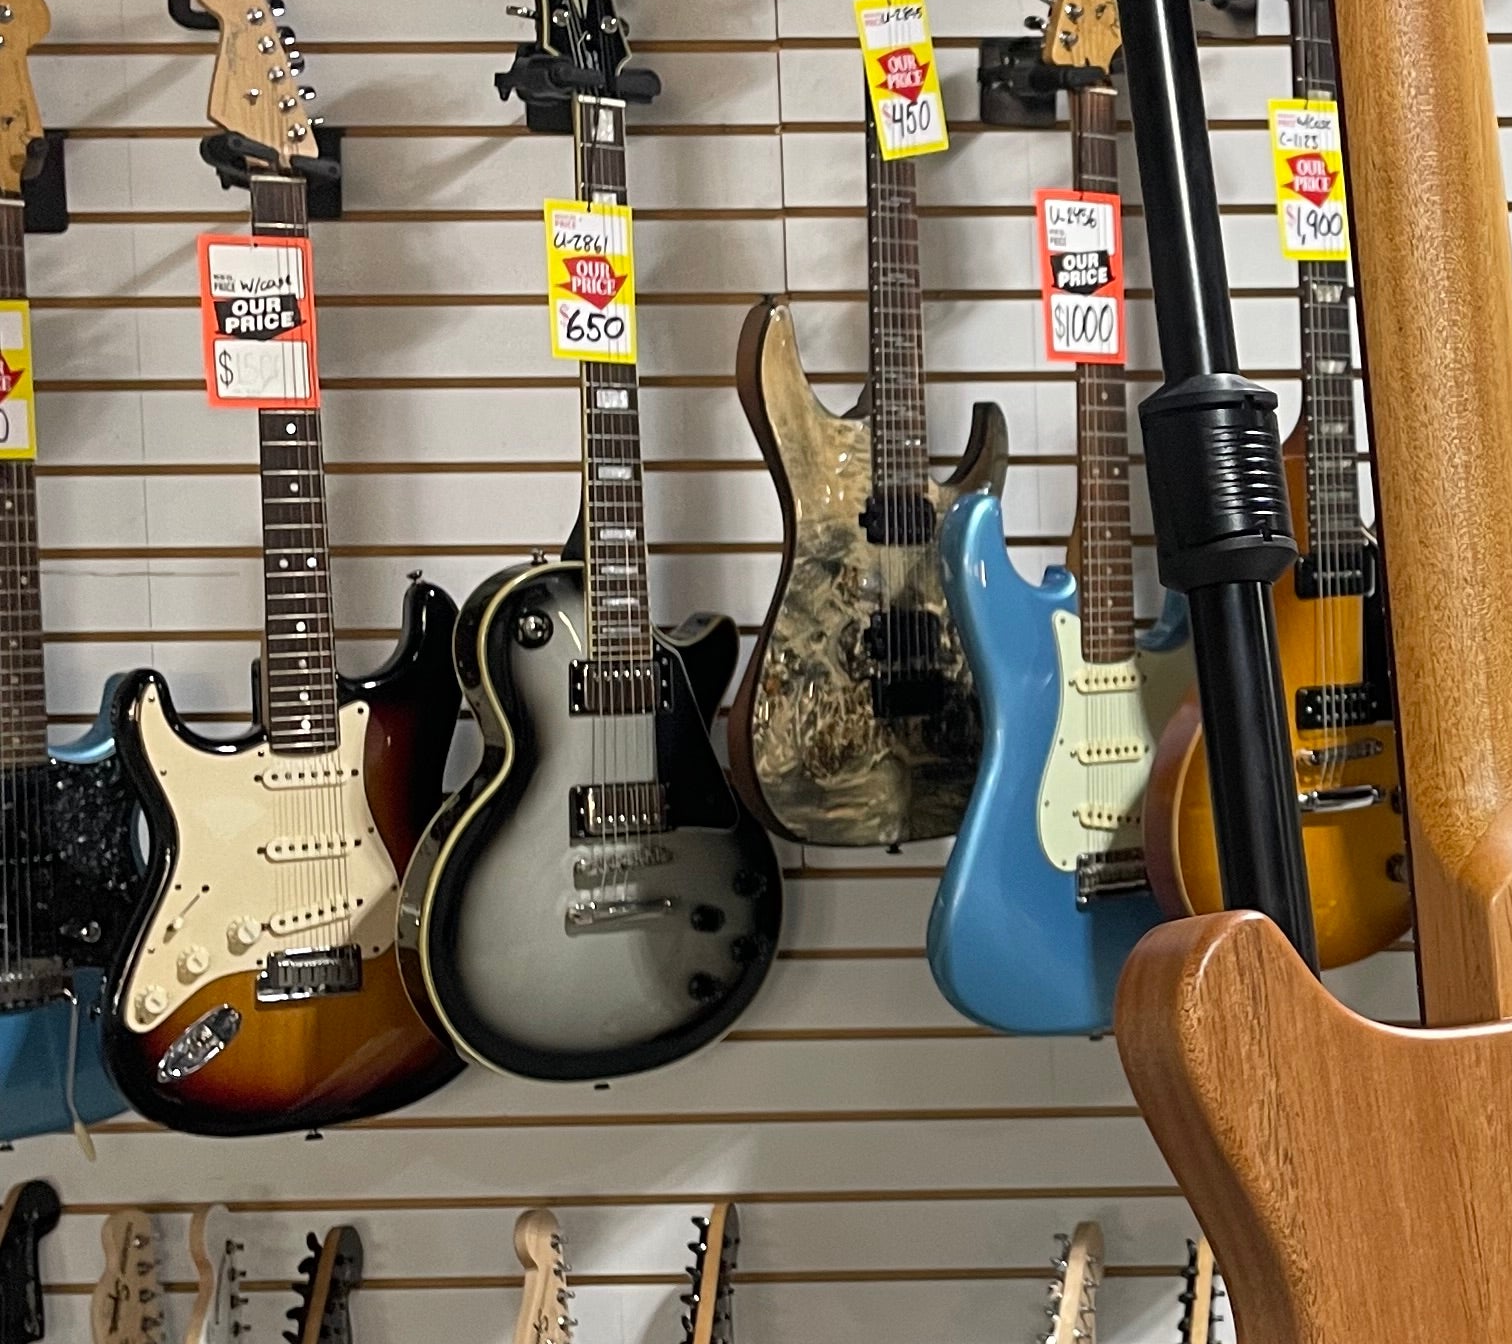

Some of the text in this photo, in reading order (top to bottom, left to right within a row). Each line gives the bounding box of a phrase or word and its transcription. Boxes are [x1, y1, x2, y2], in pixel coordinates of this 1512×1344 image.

[887, 54, 917, 74] OUR
[886, 70, 924, 91] PRICE
[1295, 159, 1326, 176] OUR
[1294, 175, 1332, 193] PRICE
[575, 259, 611, 279] OUR
[1061, 253, 1100, 271] OUR
[571, 275, 618, 297] PRICE
[1056, 267, 1109, 289] PRICE
[230, 297, 282, 317] OUR
[224, 311, 296, 335] PRICE
[1054, 303, 1114, 348] $1000
